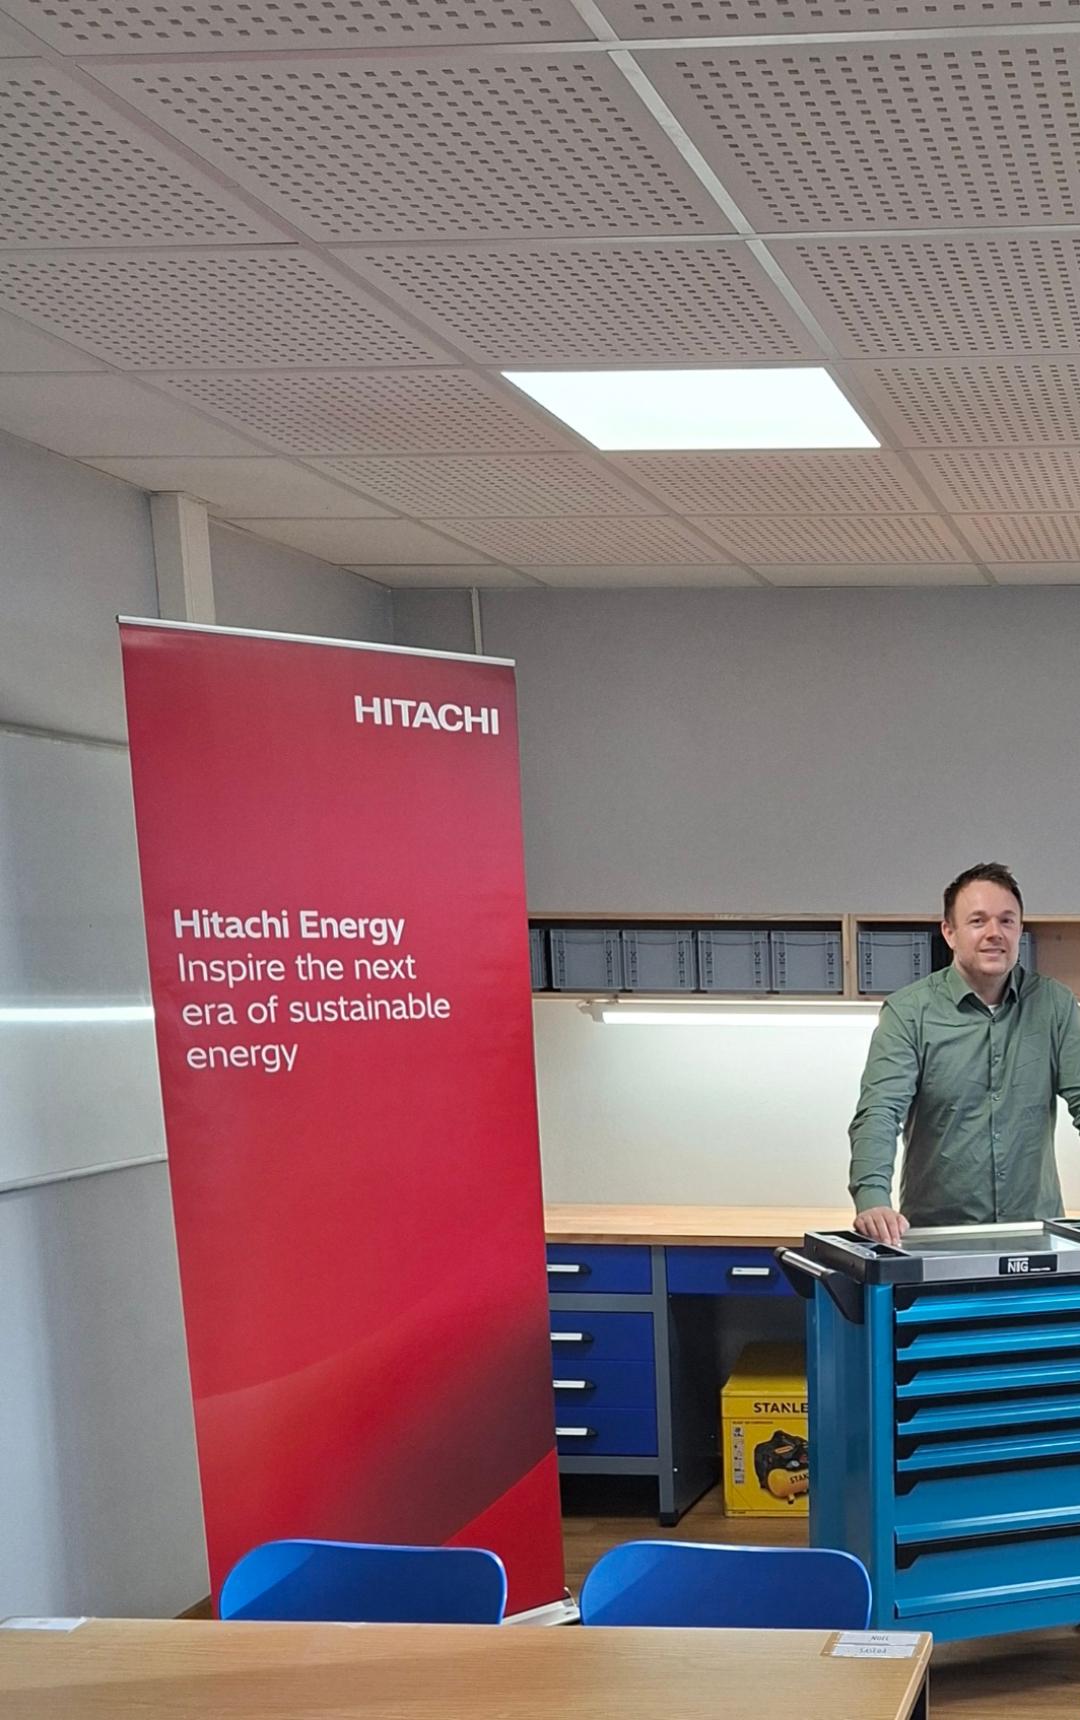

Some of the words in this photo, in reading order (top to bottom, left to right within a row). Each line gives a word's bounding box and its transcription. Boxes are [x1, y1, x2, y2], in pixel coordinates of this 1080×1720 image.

[355, 696, 499, 734] HITACHI
[175, 910, 289, 938] Hitachi
[300, 911, 404, 945] Energy
[179, 954, 284, 988] Inspire
[296, 953, 343, 980] the
[355, 955, 416, 979] next
[183, 1004, 237, 1025] era
[248, 996, 278, 1023] of
[290, 993, 450, 1022] sustainable
[187, 1045, 297, 1072] energy
[753, 1402, 808, 1413] STANLE
